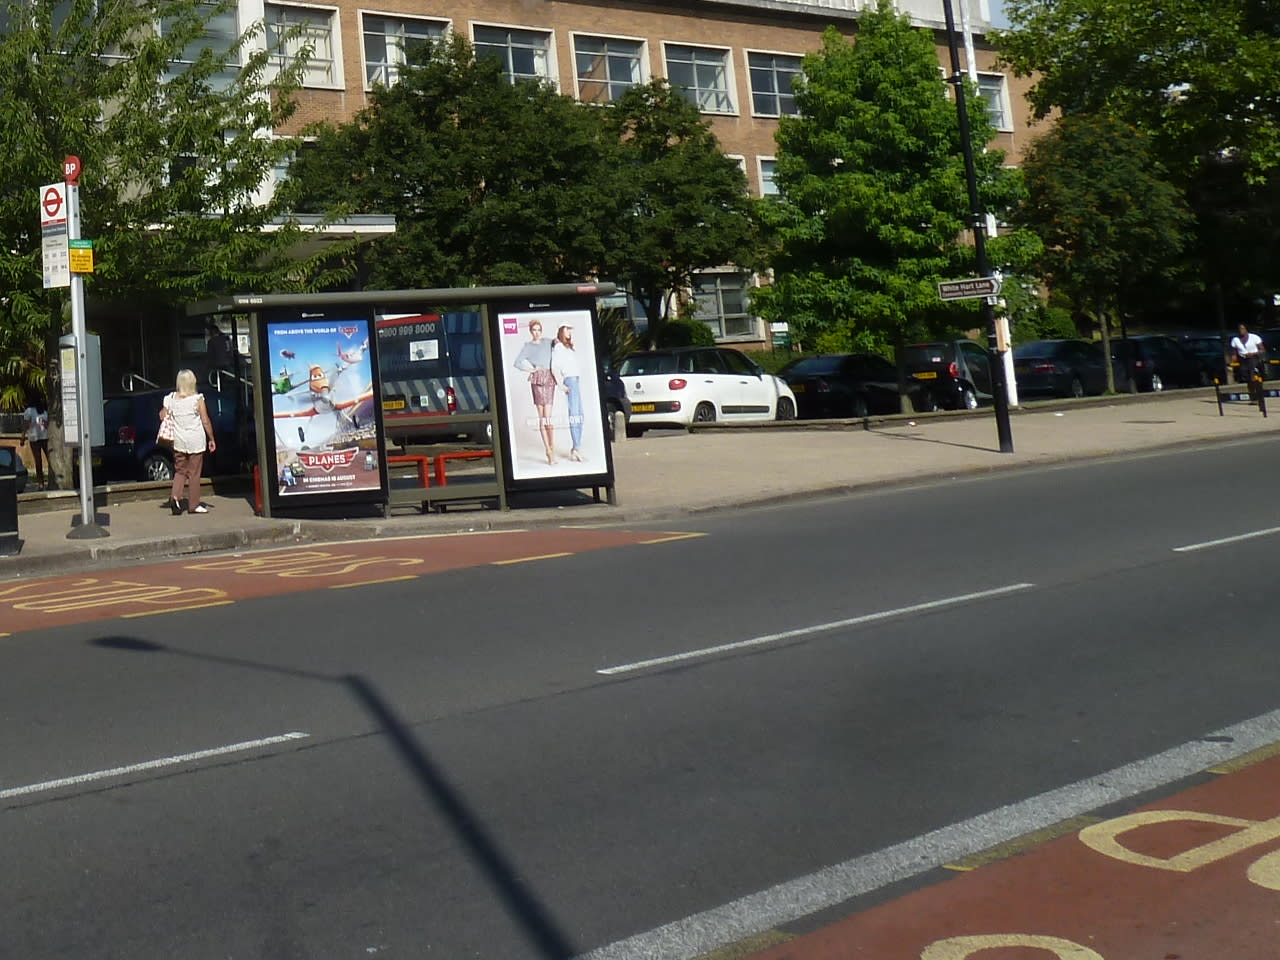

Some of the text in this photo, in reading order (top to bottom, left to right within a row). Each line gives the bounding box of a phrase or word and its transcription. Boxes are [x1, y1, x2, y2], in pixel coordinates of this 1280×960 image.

[65, 163, 76, 175] BP
[398, 325, 413, 335] 999
[415, 323, 435, 334] 8000
[308, 454, 346, 465] PLANES
[184, 551, 425, 578] BUS
